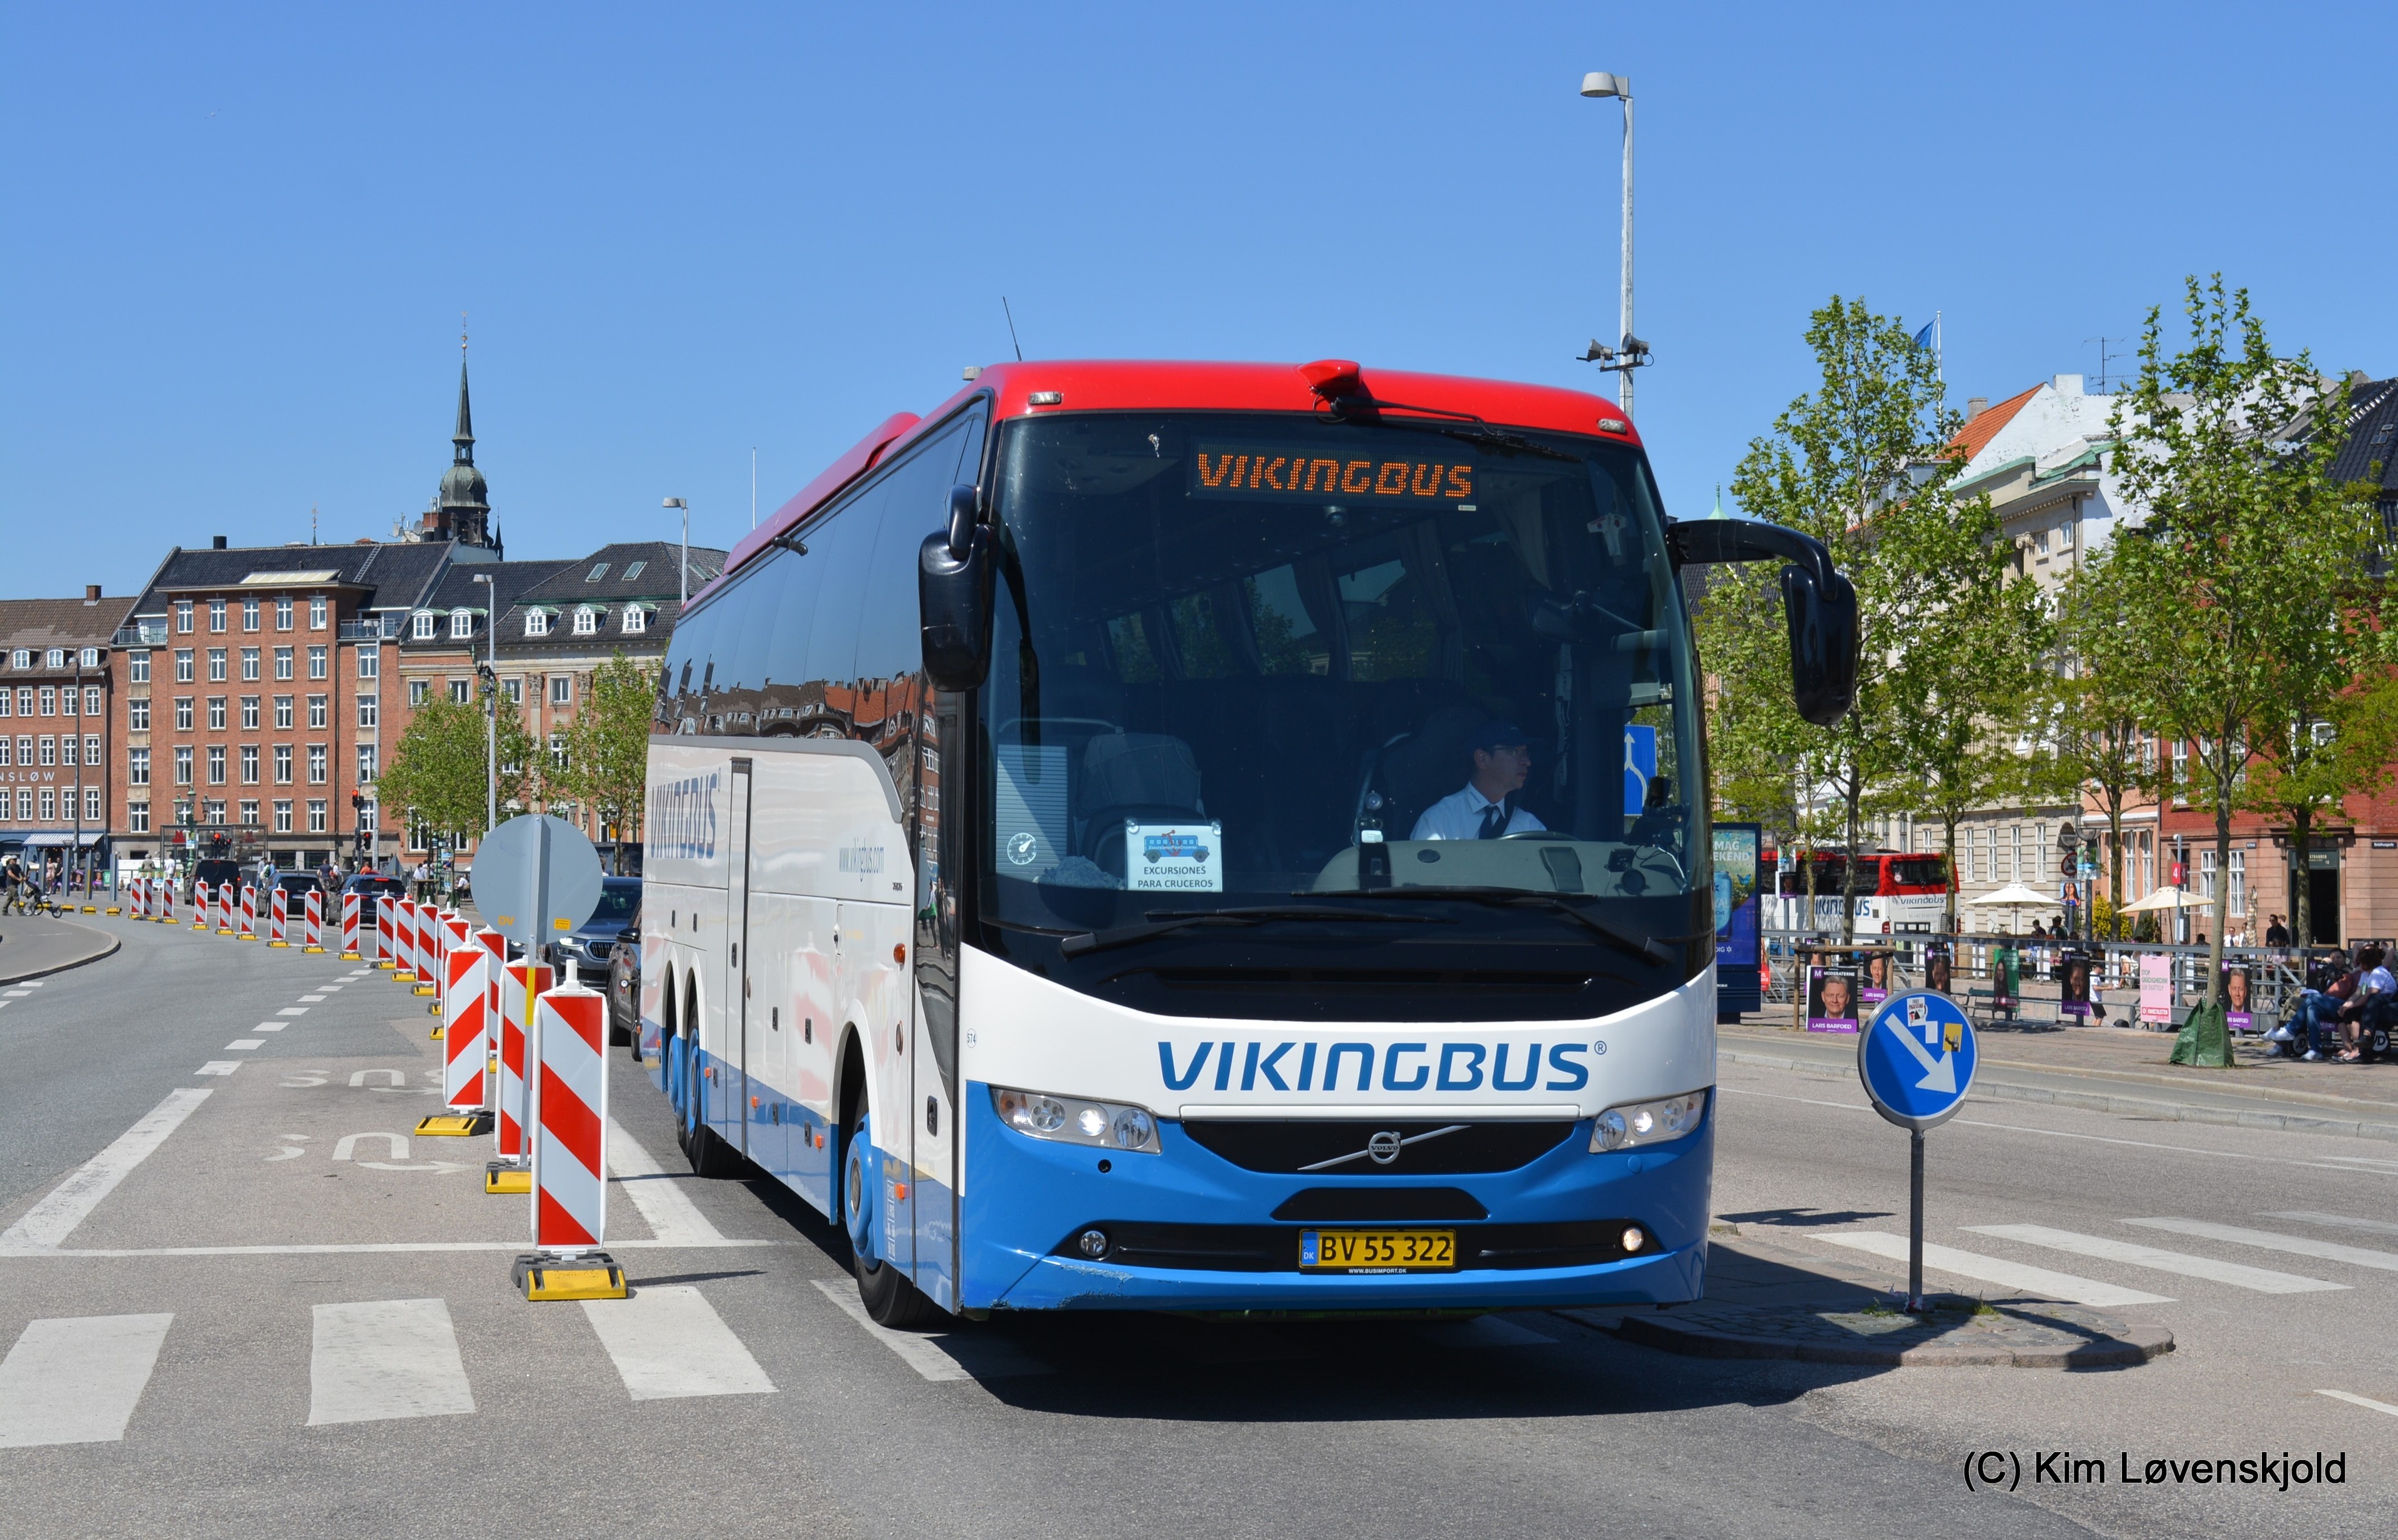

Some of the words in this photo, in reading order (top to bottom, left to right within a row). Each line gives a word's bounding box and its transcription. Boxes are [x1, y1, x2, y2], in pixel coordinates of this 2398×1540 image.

[1198, 453, 1472, 497] VIKINGBUS
[1714, 841, 1739, 851] MAG
[1713, 851, 1749, 861] EKEND
[1144, 866, 1206, 875] EXCURSIONES
[2173, 868, 2178, 879] 4
[1165, 880, 1213, 888] CRUCEROS
[498, 915, 515, 925] DV
[967, 1033, 976, 1044] 574
[1321, 1236, 1356, 1261] BV
[1364, 1236, 1395, 1261] 55
[1403, 1236, 1451, 1261] 322
[1303, 1251, 1315, 1260] DK
